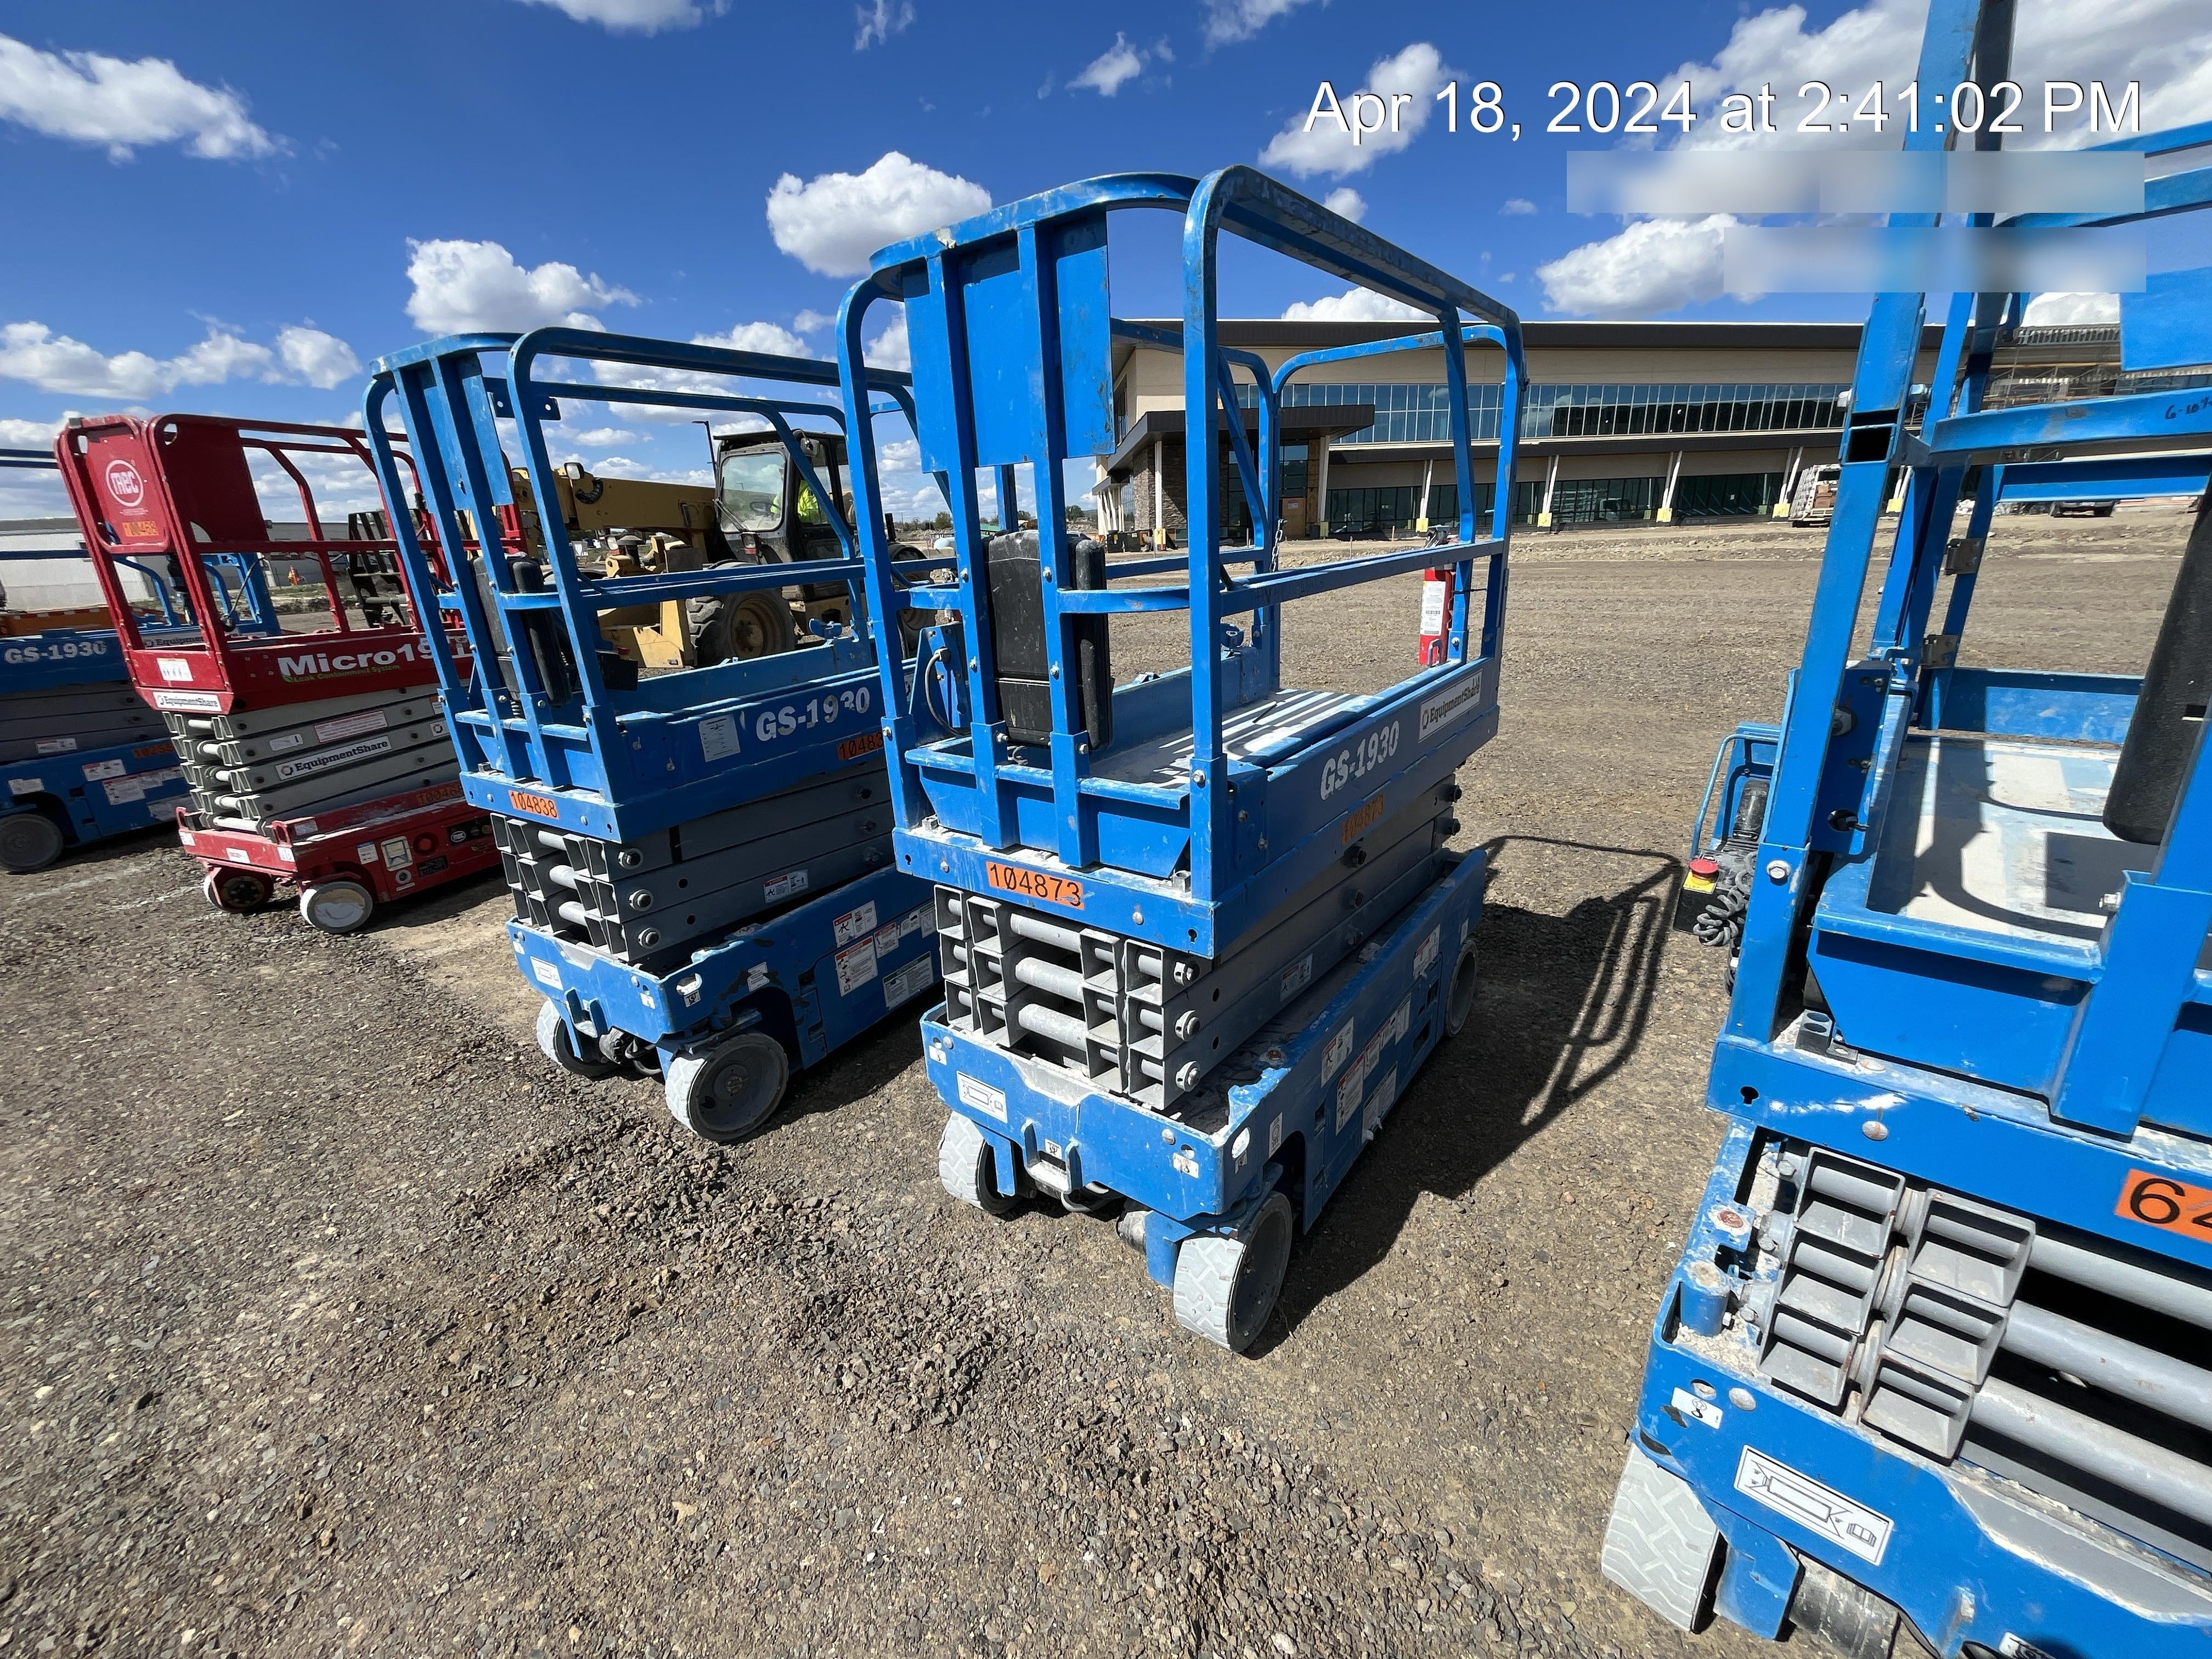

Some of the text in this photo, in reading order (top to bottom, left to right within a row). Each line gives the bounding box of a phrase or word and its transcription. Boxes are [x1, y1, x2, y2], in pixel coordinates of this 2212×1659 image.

[4, 640, 107, 664] GS-1930
[1429, 676, 1480, 723] EquipmentShare
[295, 740, 388, 772] EquipmentShare
[839, 732, 883, 758] 10483
[1321, 720, 1400, 800] GS-1930
[511, 792, 557, 818] 104838
[990, 864, 1081, 907] 104873
